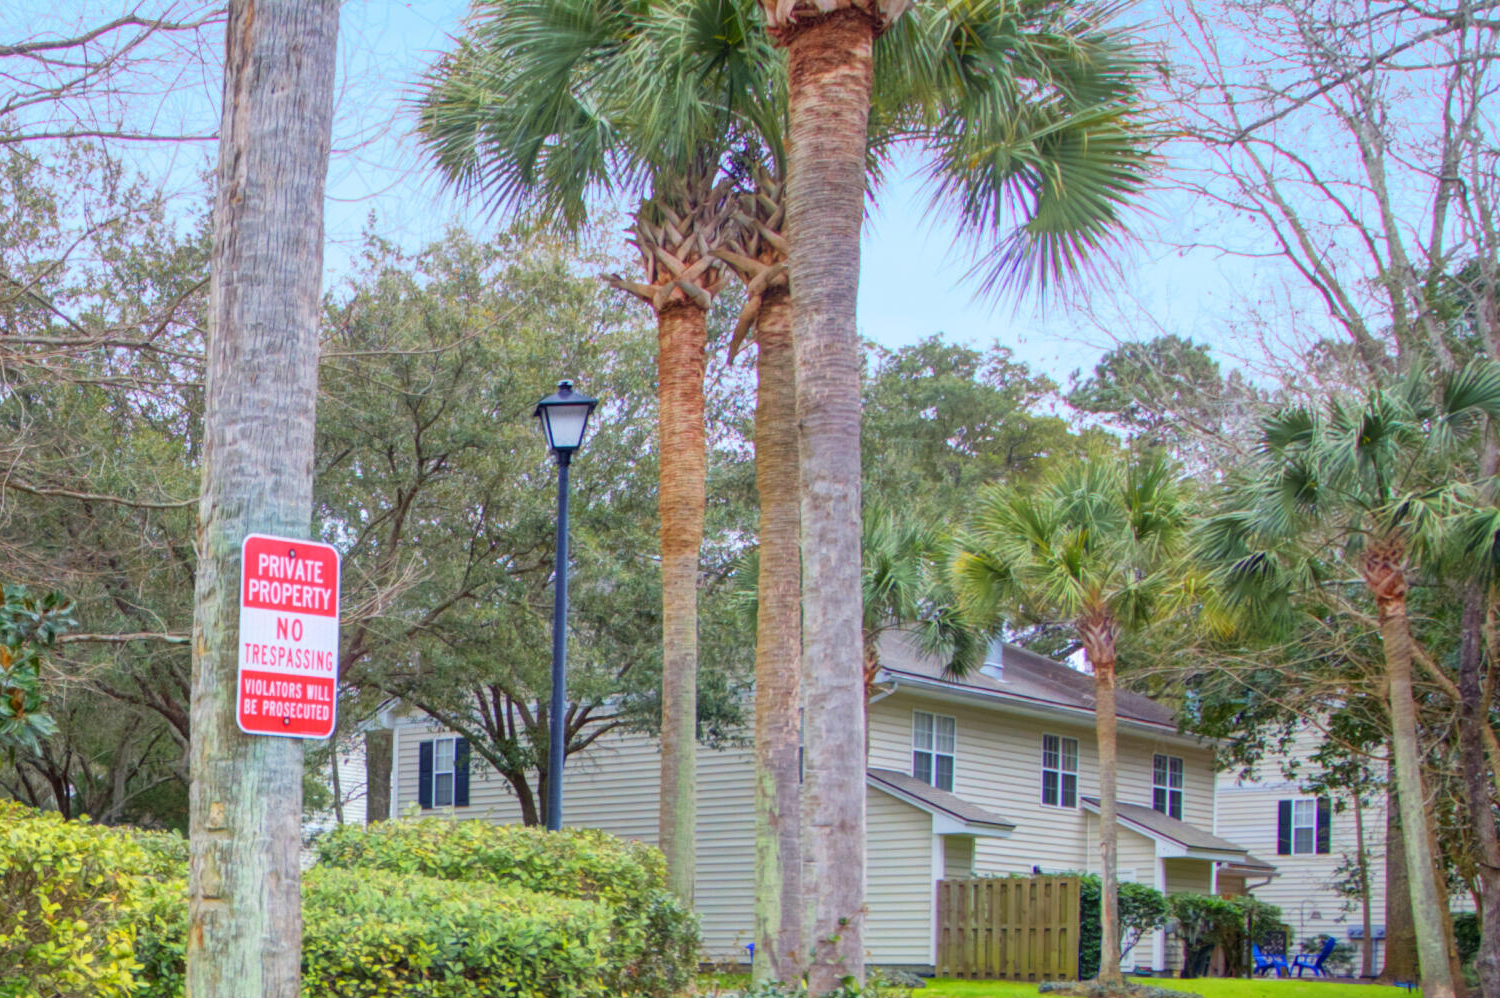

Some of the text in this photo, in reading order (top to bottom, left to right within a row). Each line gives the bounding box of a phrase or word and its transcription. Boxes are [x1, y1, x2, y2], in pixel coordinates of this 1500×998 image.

[258, 553, 324, 583] PRIVATE
[248, 579, 332, 610] PROPERTY
[276, 617, 303, 642] NO
[244, 643, 333, 671] TRESPASSING
[244, 678, 330, 701] VIOLATORS WILL
[243, 698, 330, 721] BE PROSECUTED
